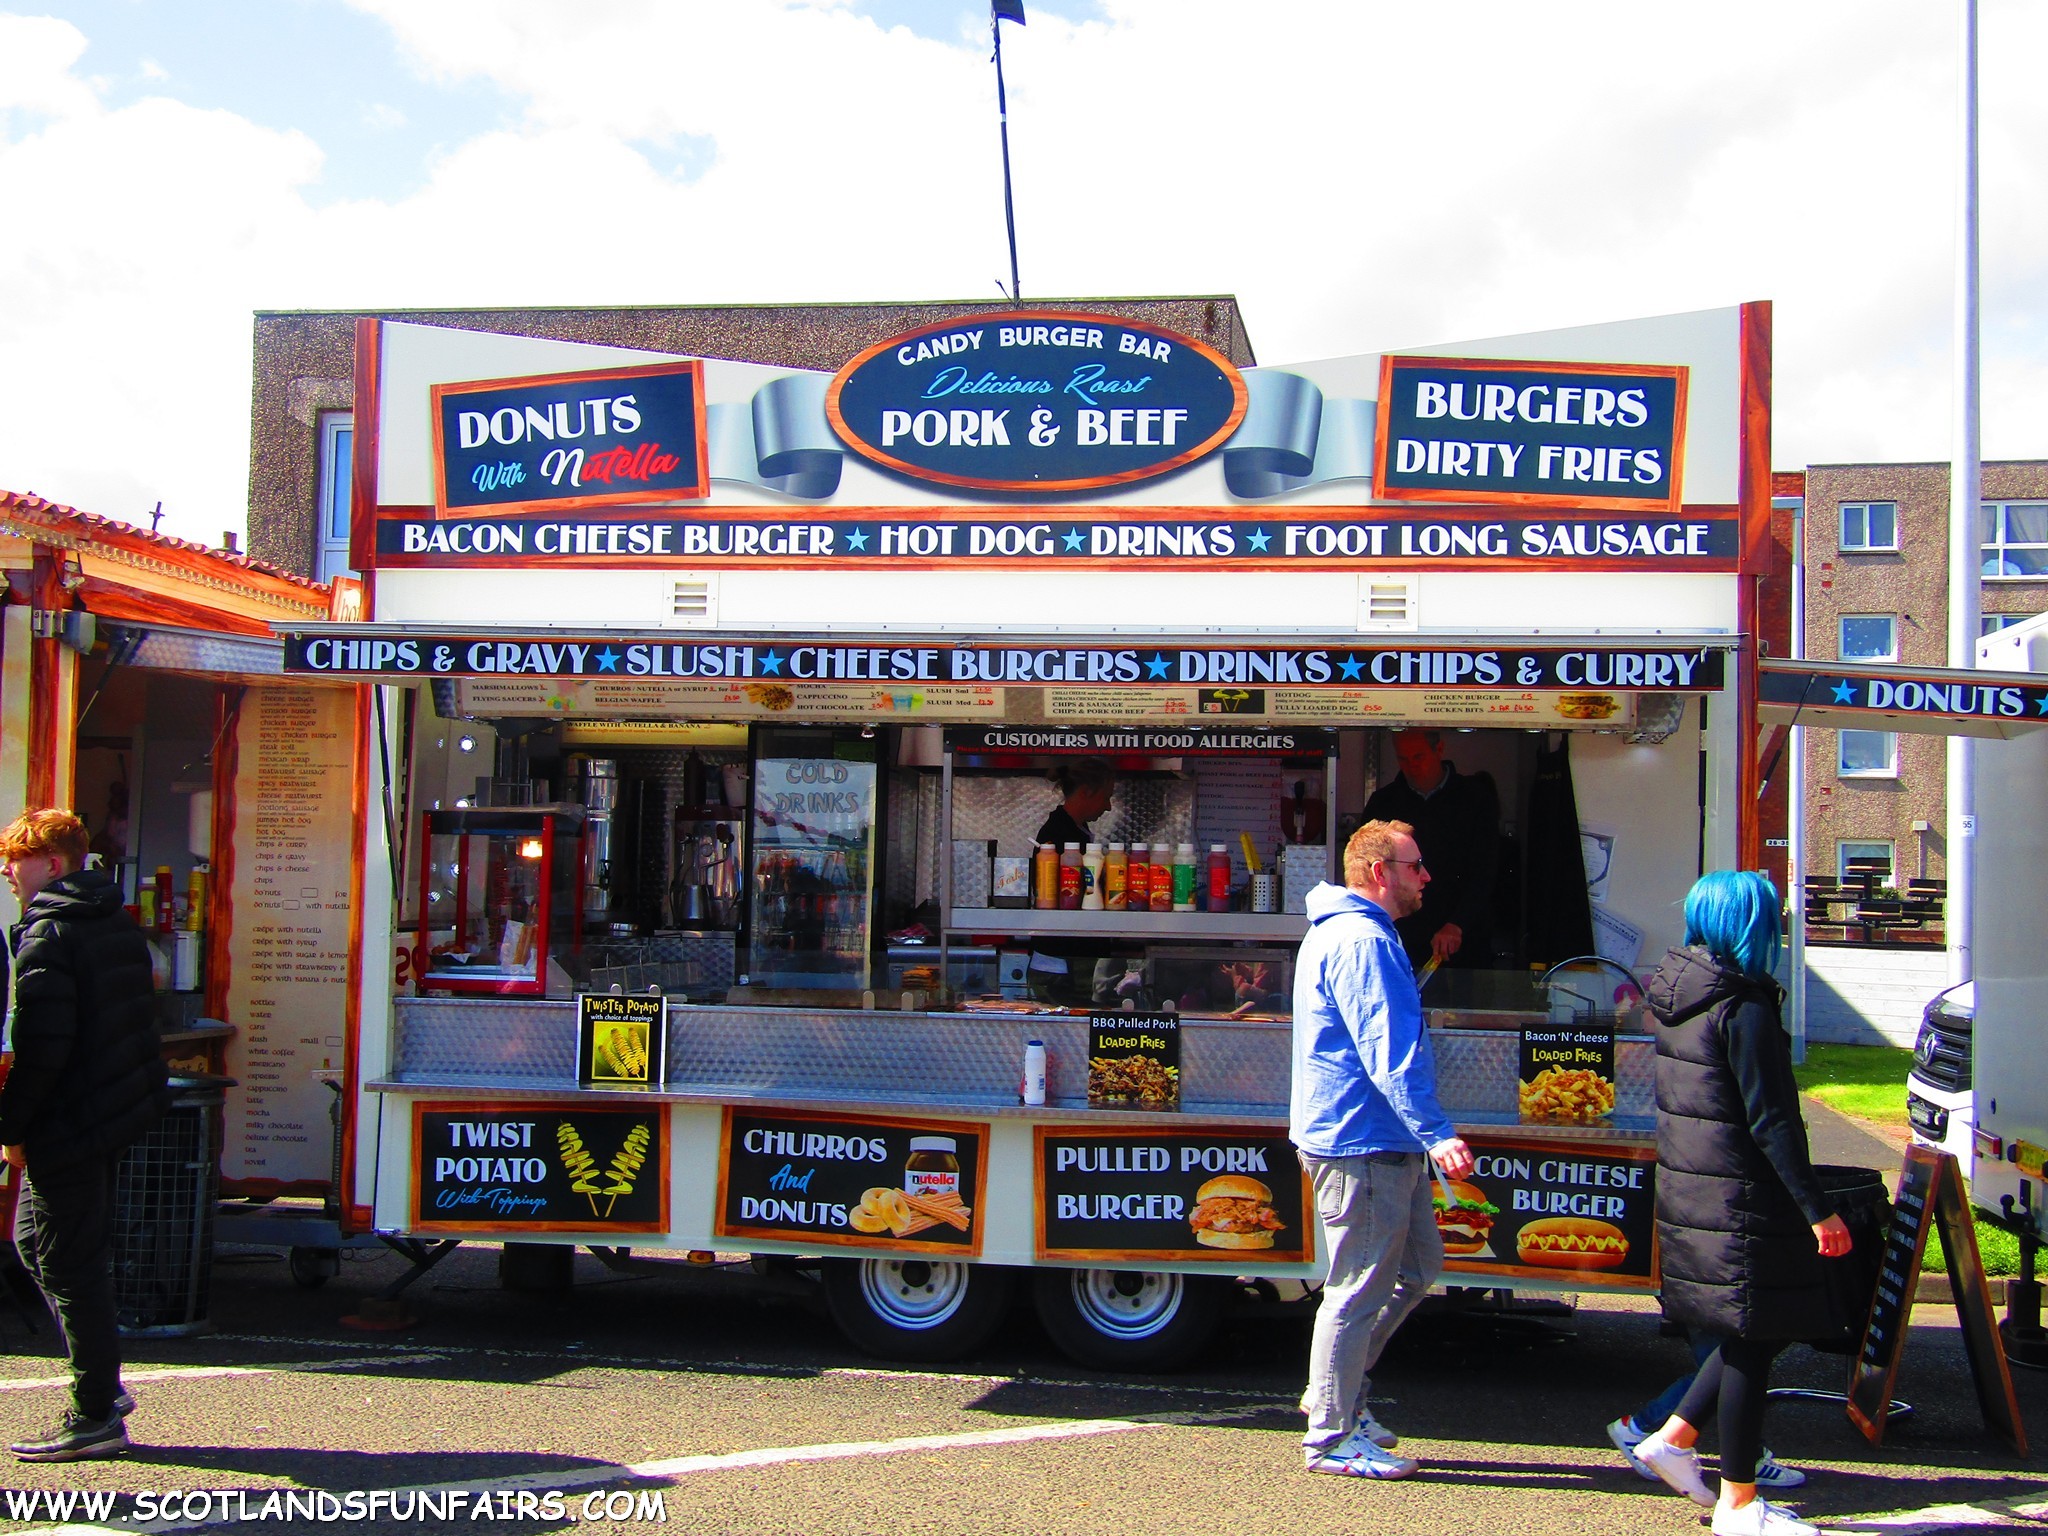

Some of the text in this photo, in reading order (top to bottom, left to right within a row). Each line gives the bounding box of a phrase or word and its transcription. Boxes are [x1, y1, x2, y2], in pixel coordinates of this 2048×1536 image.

[897, 326, 1172, 366] CANDY BURGER BAR
[920, 364, 1152, 405] Delicious Roast
[1415, 381, 1649, 428] BURGERS
[458, 395, 642, 449] DONUTS
[881, 408, 1189, 447] PORK & BEEF
[471, 443, 680, 492] With Nutella
[1396, 439, 1662, 484] DIRTY FRIES
[404, 523, 834, 556] BACON CHEESE BURGER
[880, 525, 1054, 555] HOT DOG
[1091, 525, 1235, 556] DRINKS
[1285, 525, 1708, 556] FOOT LONG SAUSAGE
[306, 639, 591, 674] CHIPS & GRAVY
[626, 643, 753, 677] SLUSH
[790, 647, 1141, 682] CHEESE BURGERS
[1179, 651, 1331, 684] DRINKS
[1371, 650, 1699, 686] CHIPS & CURRY
[1867, 680, 2024, 717] DONUTS
[984, 732, 1294, 748] CUSTOMERS WITH FOOD ALLERGIES
[786, 762, 848, 784] COLD
[775, 792, 858, 813] DRINKS
[627, 999, 659, 1014] POTATO
[1092, 1017, 1177, 1029] BBQ Pulled Pork
[1525, 1030, 1556, 1041] Bacon
[1574, 1032, 1609, 1043] cheese
[1099, 1035, 1166, 1049] LOADED FRIES
[1532, 1048, 1602, 1063] LOADED FRIES
[448, 1122, 536, 1148] TWIST
[743, 1129, 888, 1163] CHURROS
[435, 1157, 547, 1183] POTATO
[1056, 1146, 1268, 1172] PULLED PORK
[1462, 1154, 1644, 1189] CON CHEESE
[769, 1163, 815, 1194] And
[911, 1170, 956, 1186] nutella
[435, 1188, 547, 1215] With Toppings
[740, 1196, 847, 1227] DONUTS
[1057, 1193, 1185, 1221] BURGER
[1512, 1188, 1625, 1219] BURGER
